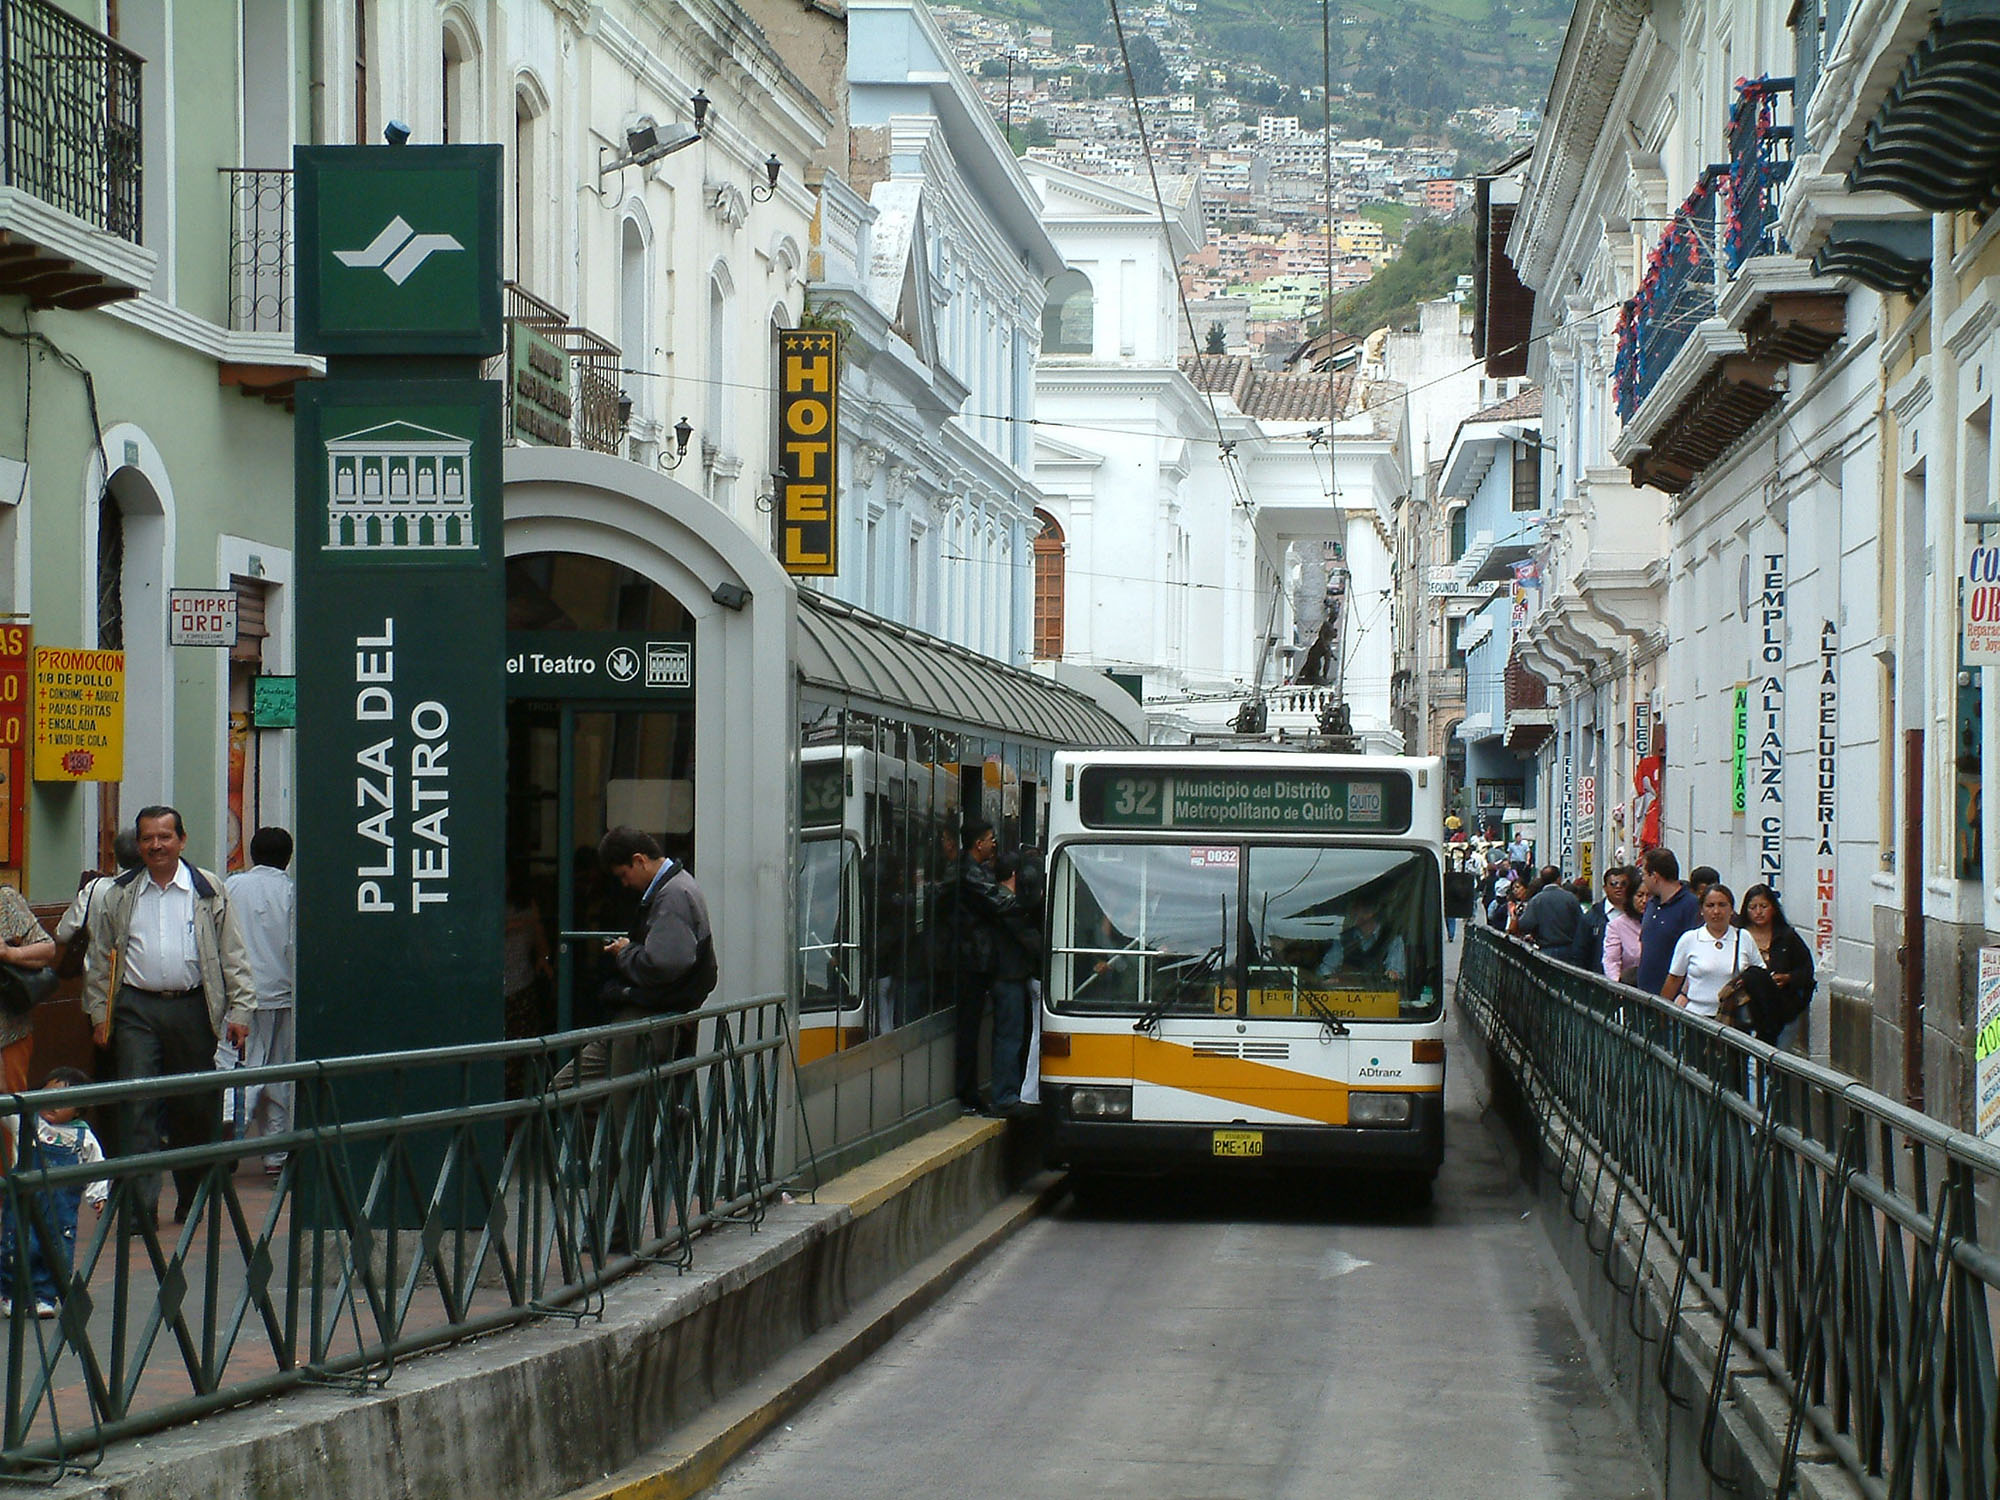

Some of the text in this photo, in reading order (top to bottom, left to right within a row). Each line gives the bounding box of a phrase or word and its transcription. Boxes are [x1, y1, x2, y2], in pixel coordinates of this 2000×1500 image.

[786, 356, 828, 564] HOTEL
[1970, 547, 2000, 583] CO
[173, 599, 237, 612] COMPRO
[1762, 555, 1784, 662] TEMPLO
[182, 615, 222, 631] ORO
[1820, 621, 1837, 684] ALTA
[1971, 638, 1980, 651] de
[38, 651, 124, 672] PROMOCION
[506, 654, 595, 673] el Teatro
[38, 673, 112, 687] 1/8 DE POLLO
[49, 704, 78, 716] PAPAS
[80, 705, 111, 717] FRITAS
[49, 718, 96, 731] ENSALADA
[49, 734, 53, 745] 1
[55, 734, 73, 745] VASO
[76, 735, 85, 746] DE
[88, 735, 107, 747] COLA
[1761, 677, 1783, 803] ALIANZA
[356, 617, 395, 914] PLAZA DEL
[1817, 692, 1837, 856] PELUQUERIA
[1115, 779, 1156, 815] 32
[1176, 781, 1331, 802] Municipio del Distrito
[1350, 794, 1380, 809] QUITO
[1585, 778, 1594, 815] ORO
[411, 700, 449, 914] TEATRO
[1175, 802, 1343, 823] Metropolitano de Quito
[1207, 850, 1236, 862] 0032
[1266, 992, 1278, 1001] EL
[1348, 993, 1361, 1003] LA
[1359, 1068, 1401, 1078] ADtranz
[1214, 1140, 1261, 1154] PME-140
